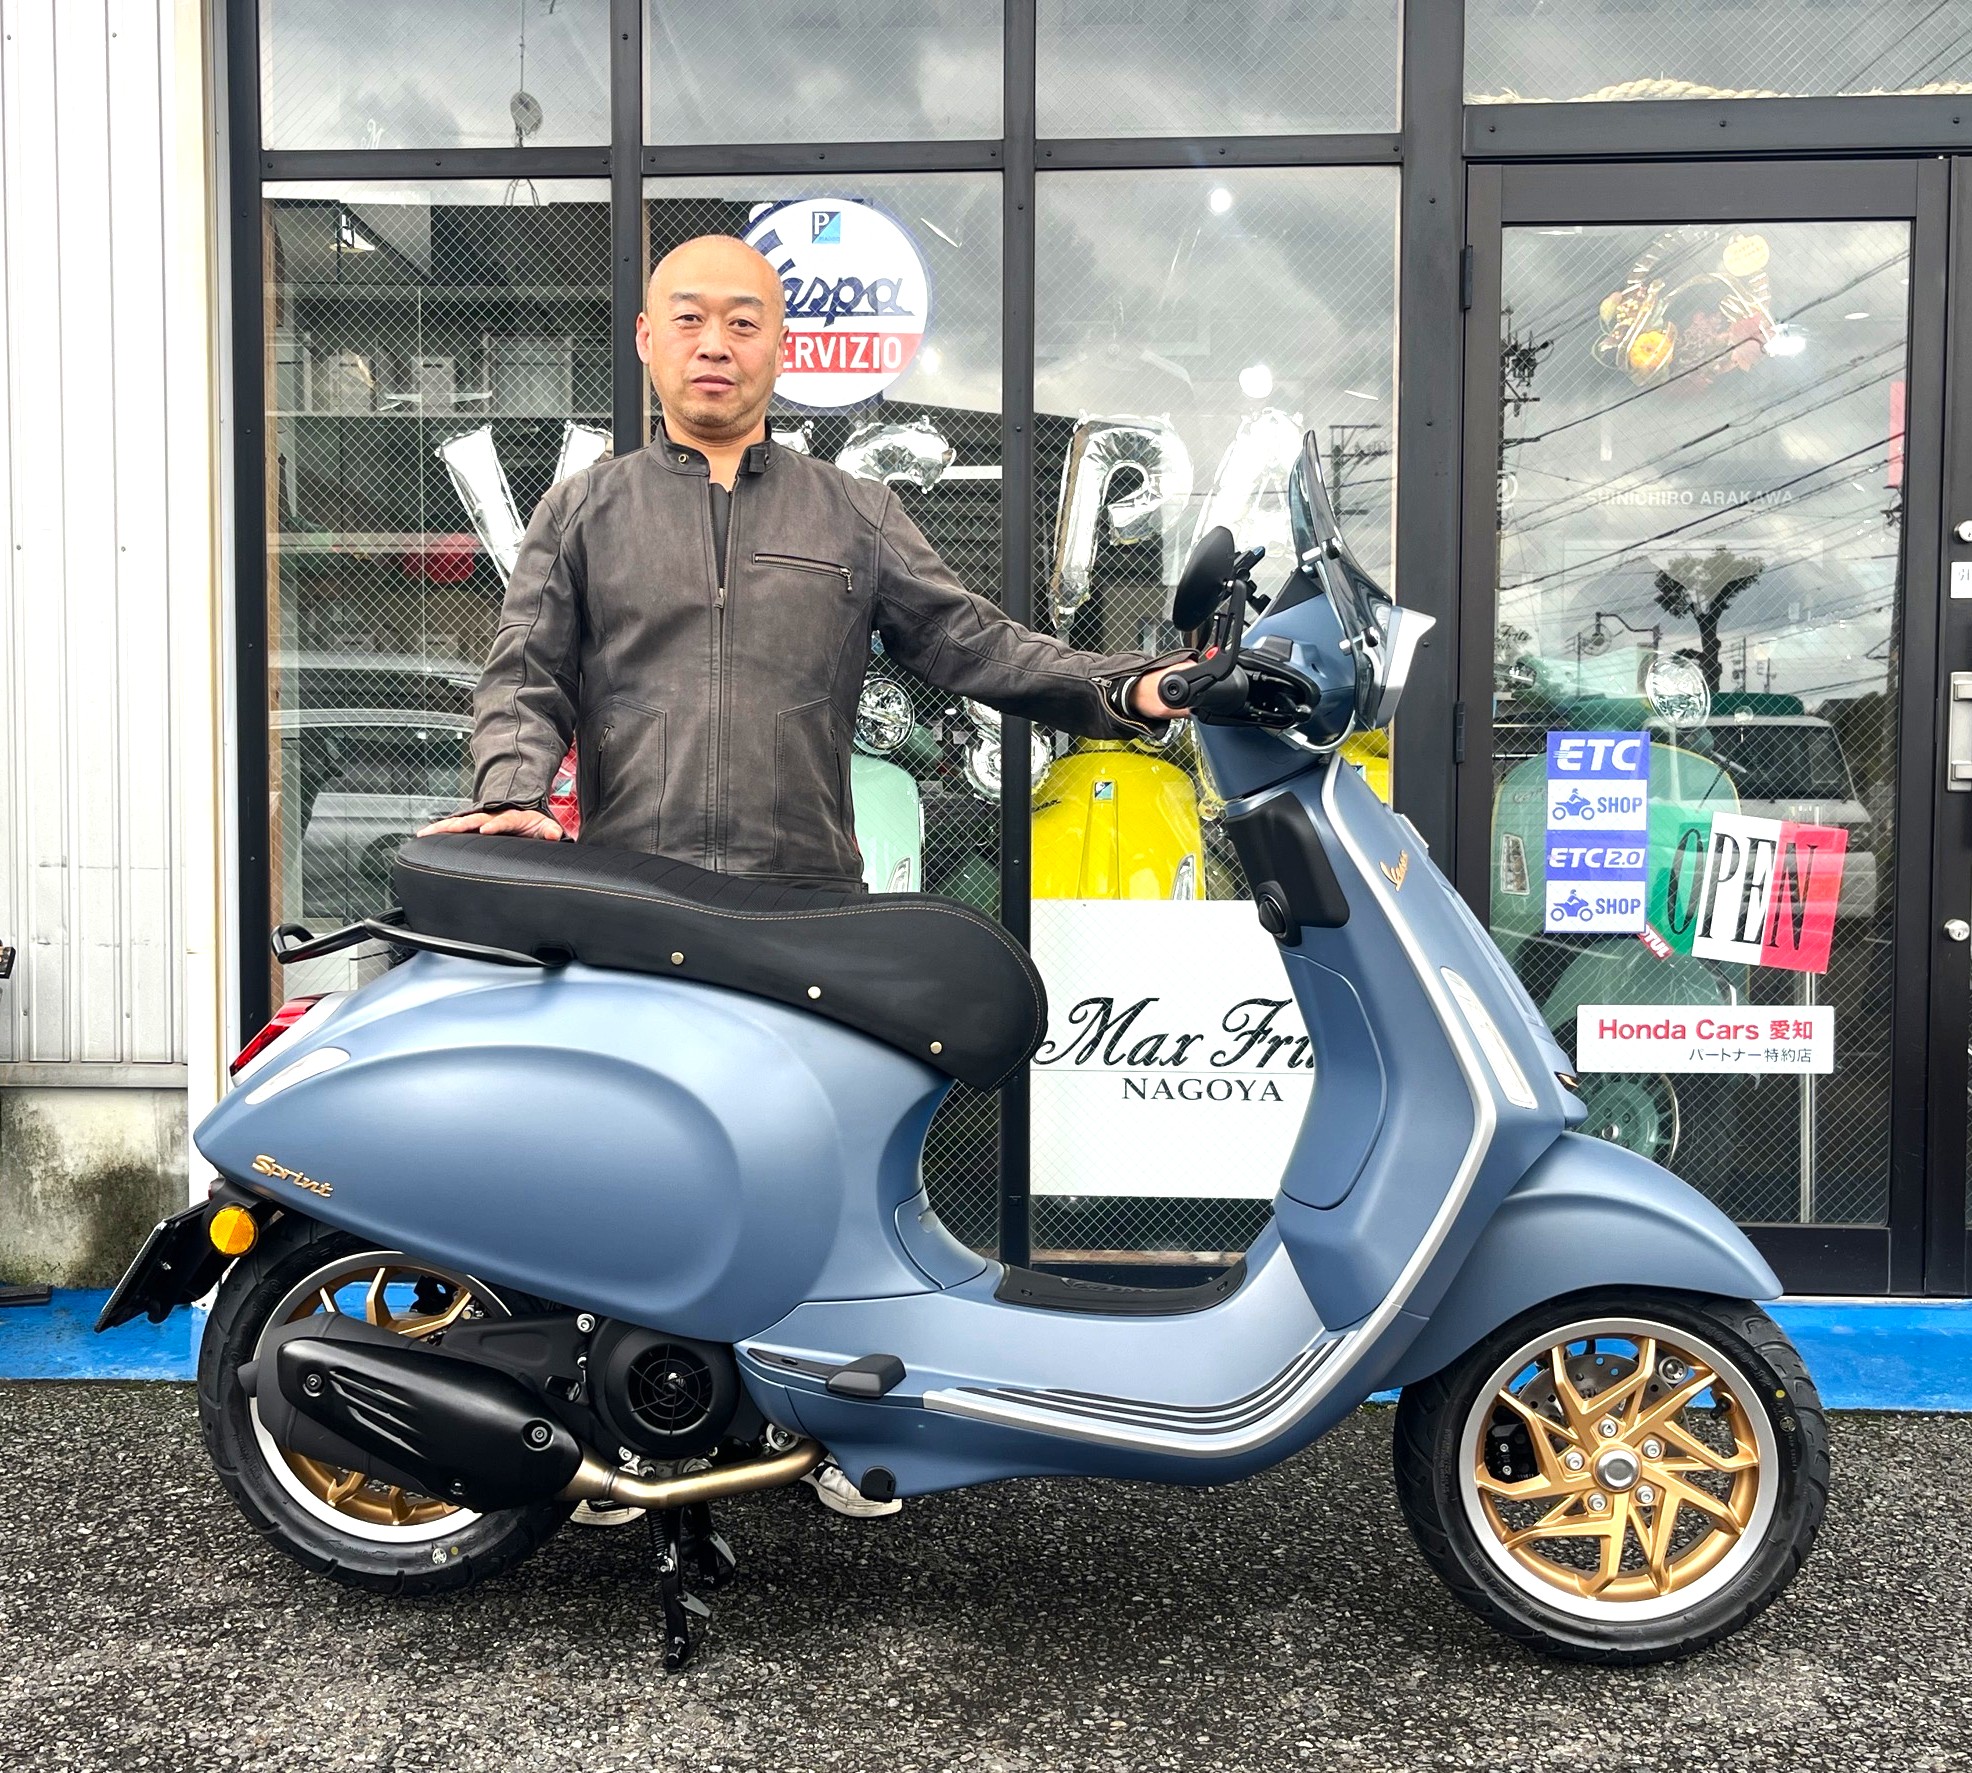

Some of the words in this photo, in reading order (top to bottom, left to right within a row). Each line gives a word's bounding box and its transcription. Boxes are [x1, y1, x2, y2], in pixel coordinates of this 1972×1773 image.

[783, 336, 902, 369] ERVIZIO
[1700, 490, 1793, 505] ARAKAWA
[1554, 738, 1641, 771] ETC
[1597, 796, 1643, 813] SHOP
[1667, 827, 1819, 951] OPEN
[1595, 897, 1641, 915] SHOP
[1640, 924, 1671, 958] TUL
[1031, 996, 1205, 1068] Max
[1209, 997, 1315, 1069] Fri
[1598, 1019, 1686, 1040] Honda
[1695, 1019, 1759, 1040] Cars
[1769, 1020, 1813, 1040] 愛知
[1122, 1077, 1284, 1102] NAGOYA
[251, 1153, 335, 1198] Sprint
